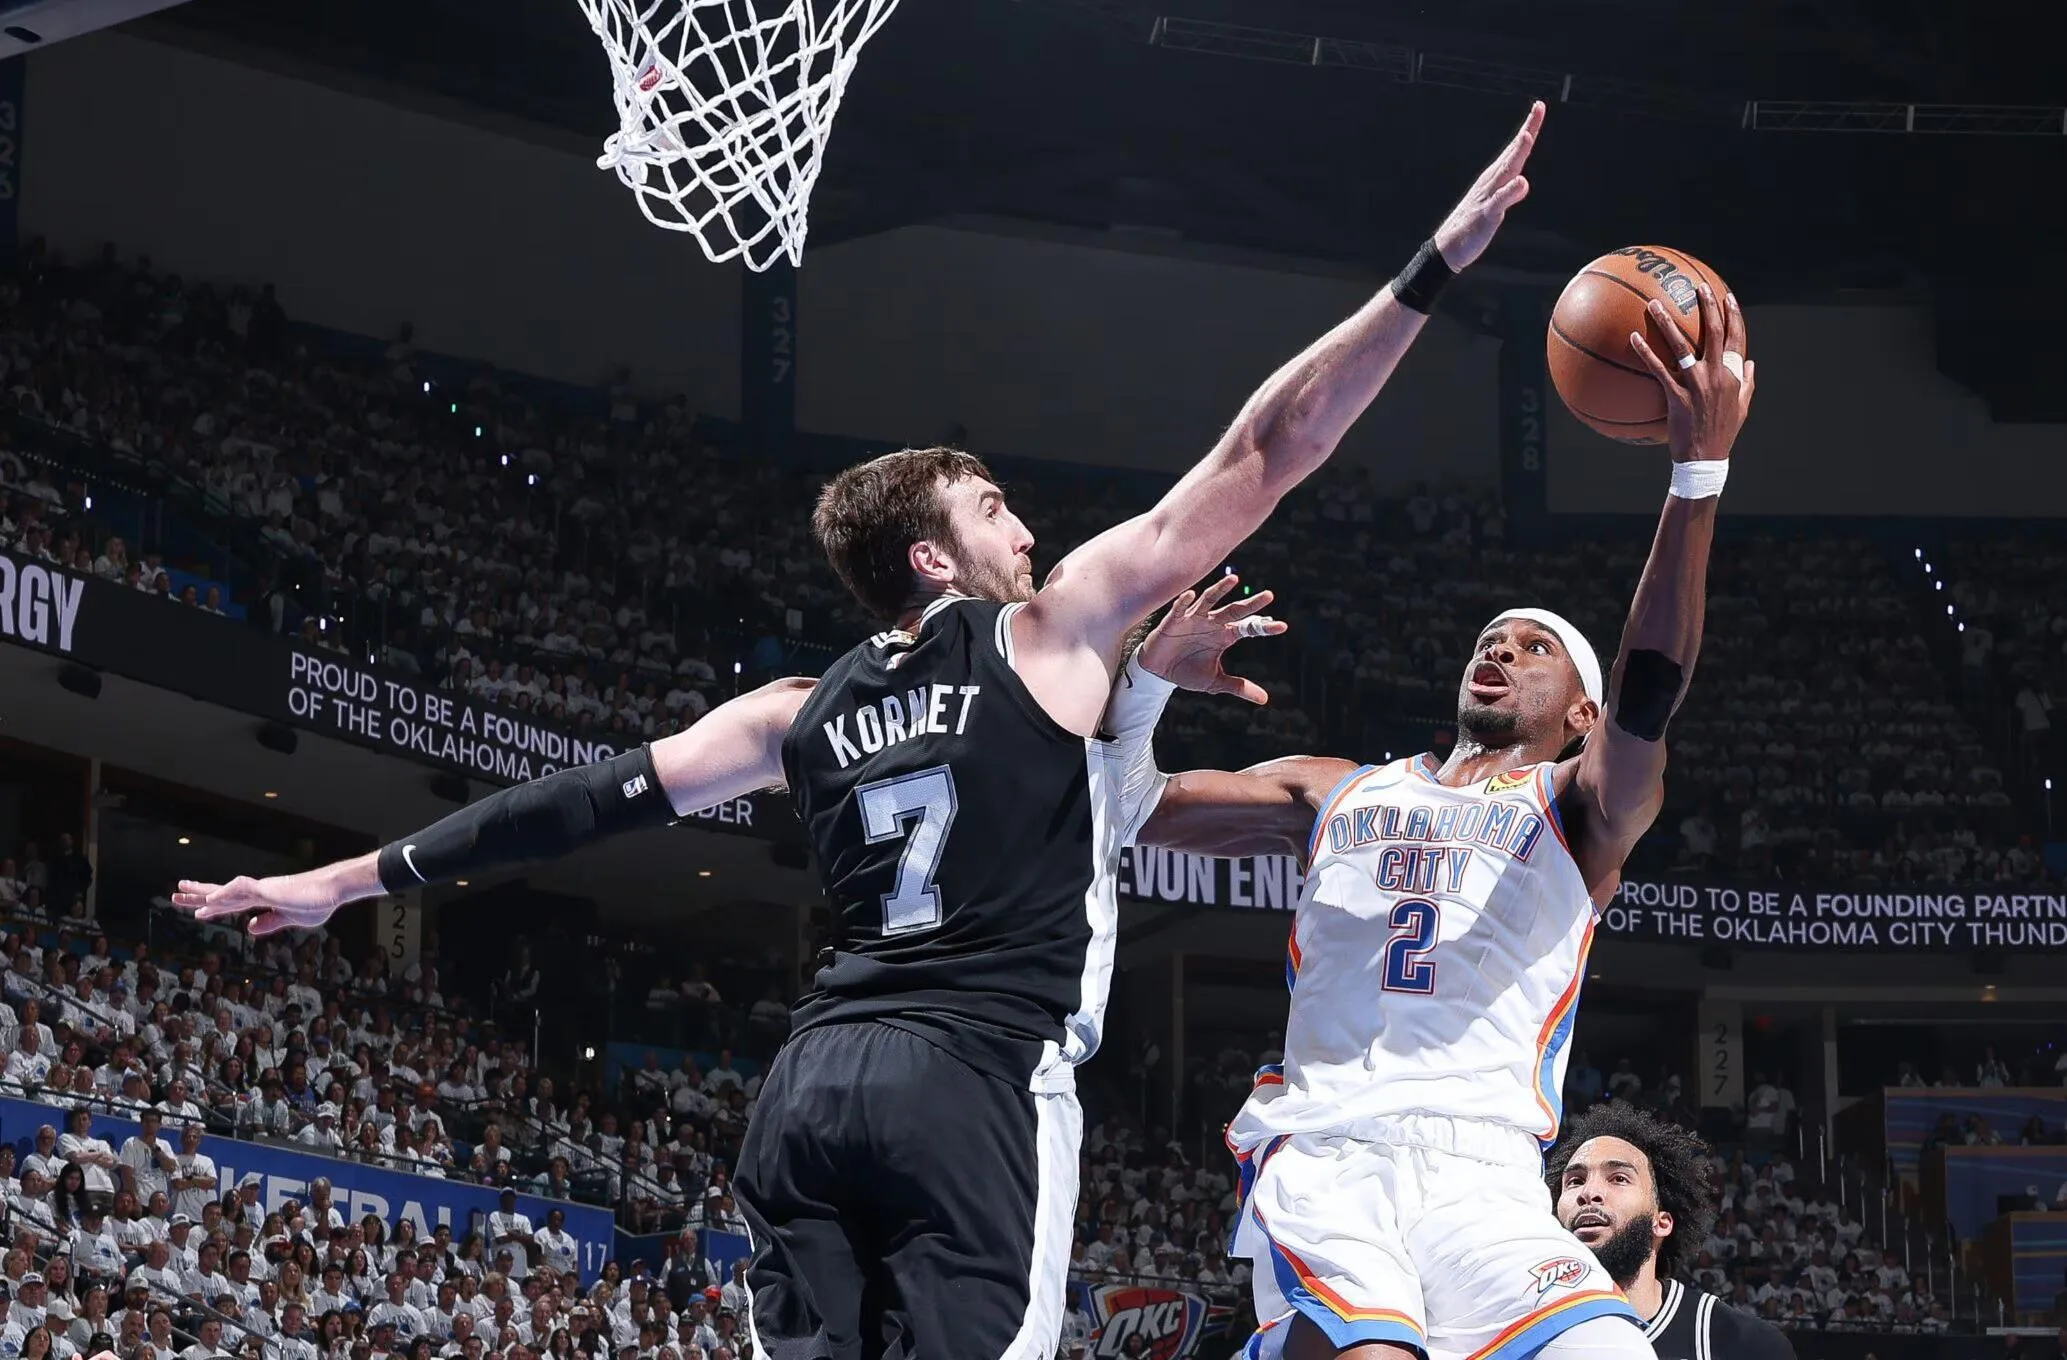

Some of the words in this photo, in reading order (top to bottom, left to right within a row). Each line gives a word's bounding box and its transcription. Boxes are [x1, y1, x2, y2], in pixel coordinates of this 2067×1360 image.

[1520, 387, 1540, 471] 328
[288, 687, 324, 720] OF
[333, 698, 381, 740] THE
[390, 717, 532, 781] OKLAHOMA
[291, 651, 378, 703] PROUD
[384, 680, 417, 715] TO
[425, 693, 454, 728] BE
[460, 706, 477, 735] A
[483, 711, 616, 766] FOUNDING
[823, 683, 980, 769] KORNET
[855, 764, 958, 936] 7
[1328, 801, 1545, 863] OKLAHOMA
[1376, 846, 1473, 895] CITY
[1705, 888, 1741, 912] TO
[1748, 891, 1781, 916] BE
[1788, 894, 1808, 917] A
[1815, 893, 1966, 918] FOUNDING
[1974, 894, 2067, 918] PARTN
[391, 893, 406, 959] 25
[1381, 898, 1440, 995] 2
[1606, 908, 1643, 932] OF
[1651, 911, 1704, 937] THE
[1713, 917, 1880, 945] OKLAHOMA
[1888, 922, 1957, 946] CITY
[1966, 922, 2067, 946] THUND
[1713, 1023, 1729, 1096] 227
[1538, 1260, 1580, 1293] OKC
[1096, 1299, 1185, 1357] OKC
